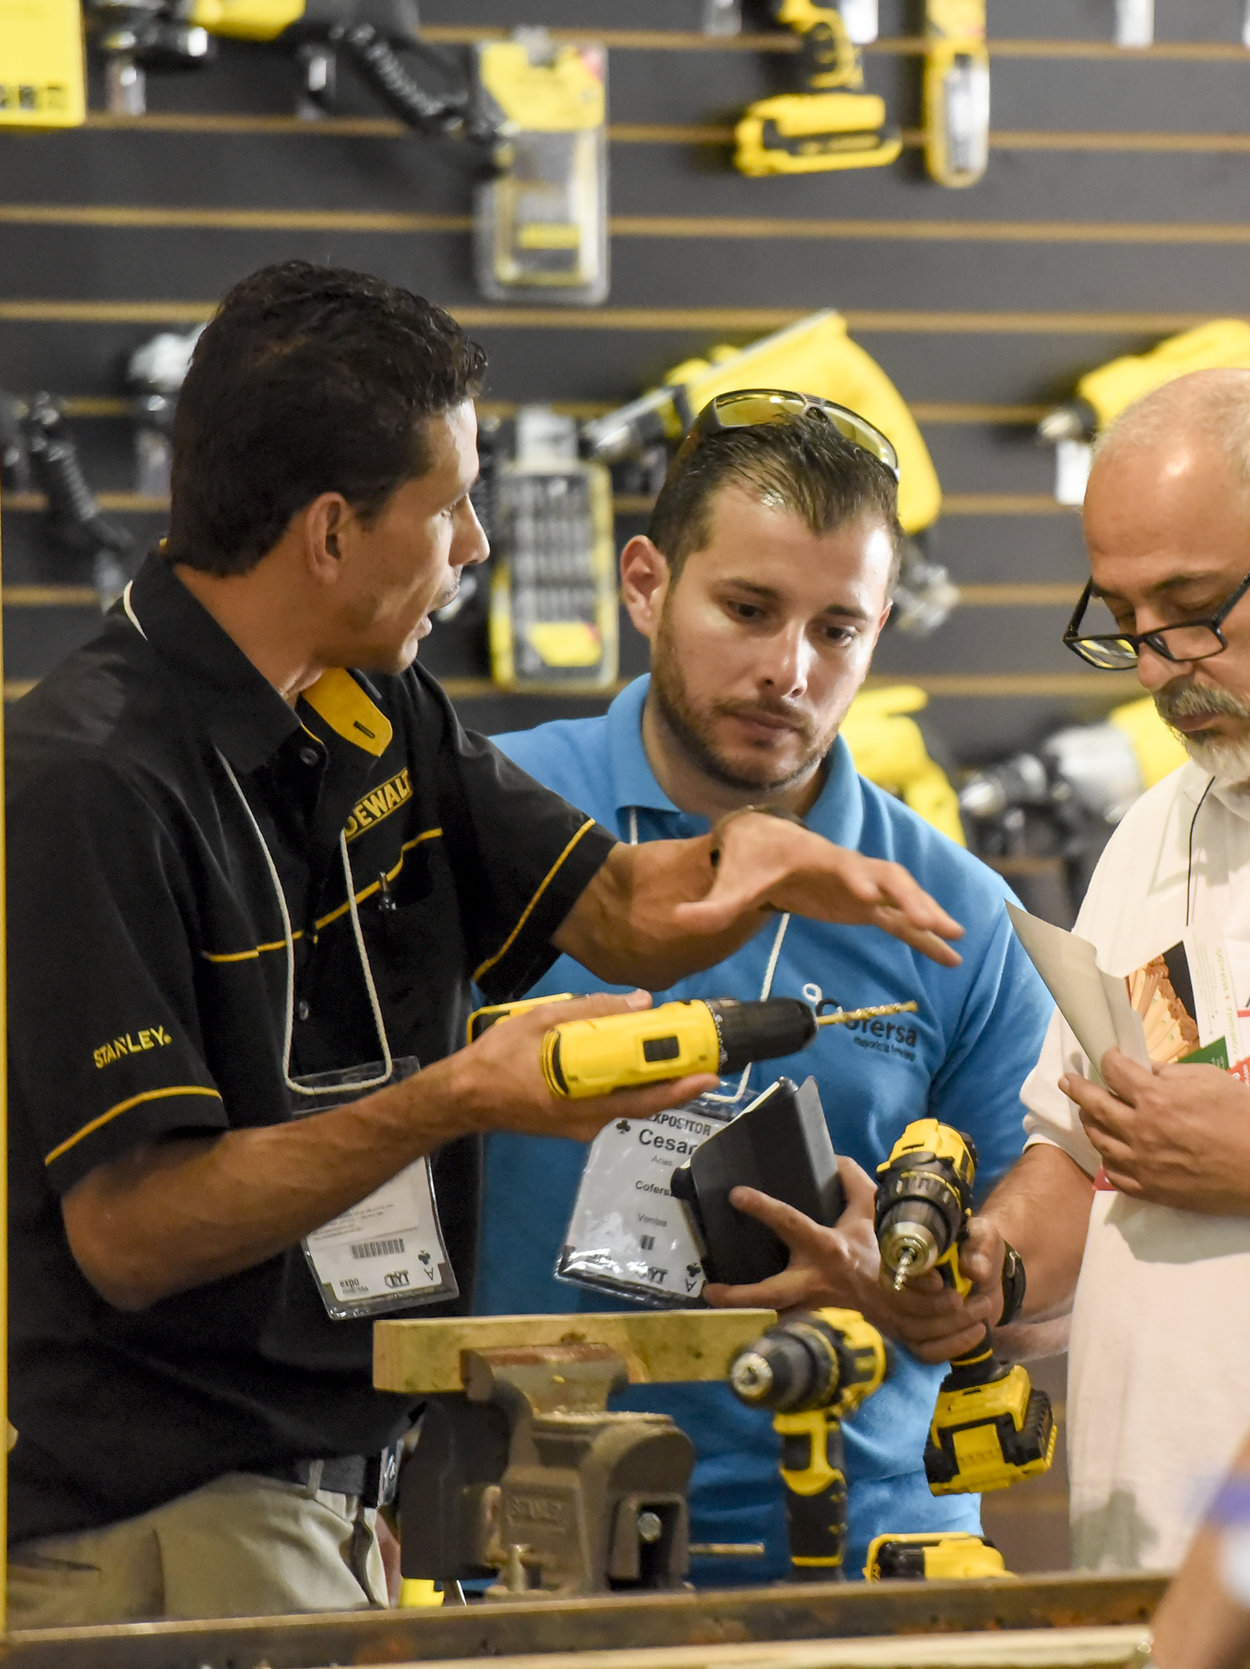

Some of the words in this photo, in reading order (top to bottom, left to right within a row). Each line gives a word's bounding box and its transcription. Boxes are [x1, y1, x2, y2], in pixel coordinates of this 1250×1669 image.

[93, 1025, 165, 1069] STANLEY
[650, 1112, 712, 1137] XPOSITOR
[638, 1128, 698, 1156] Cesar
